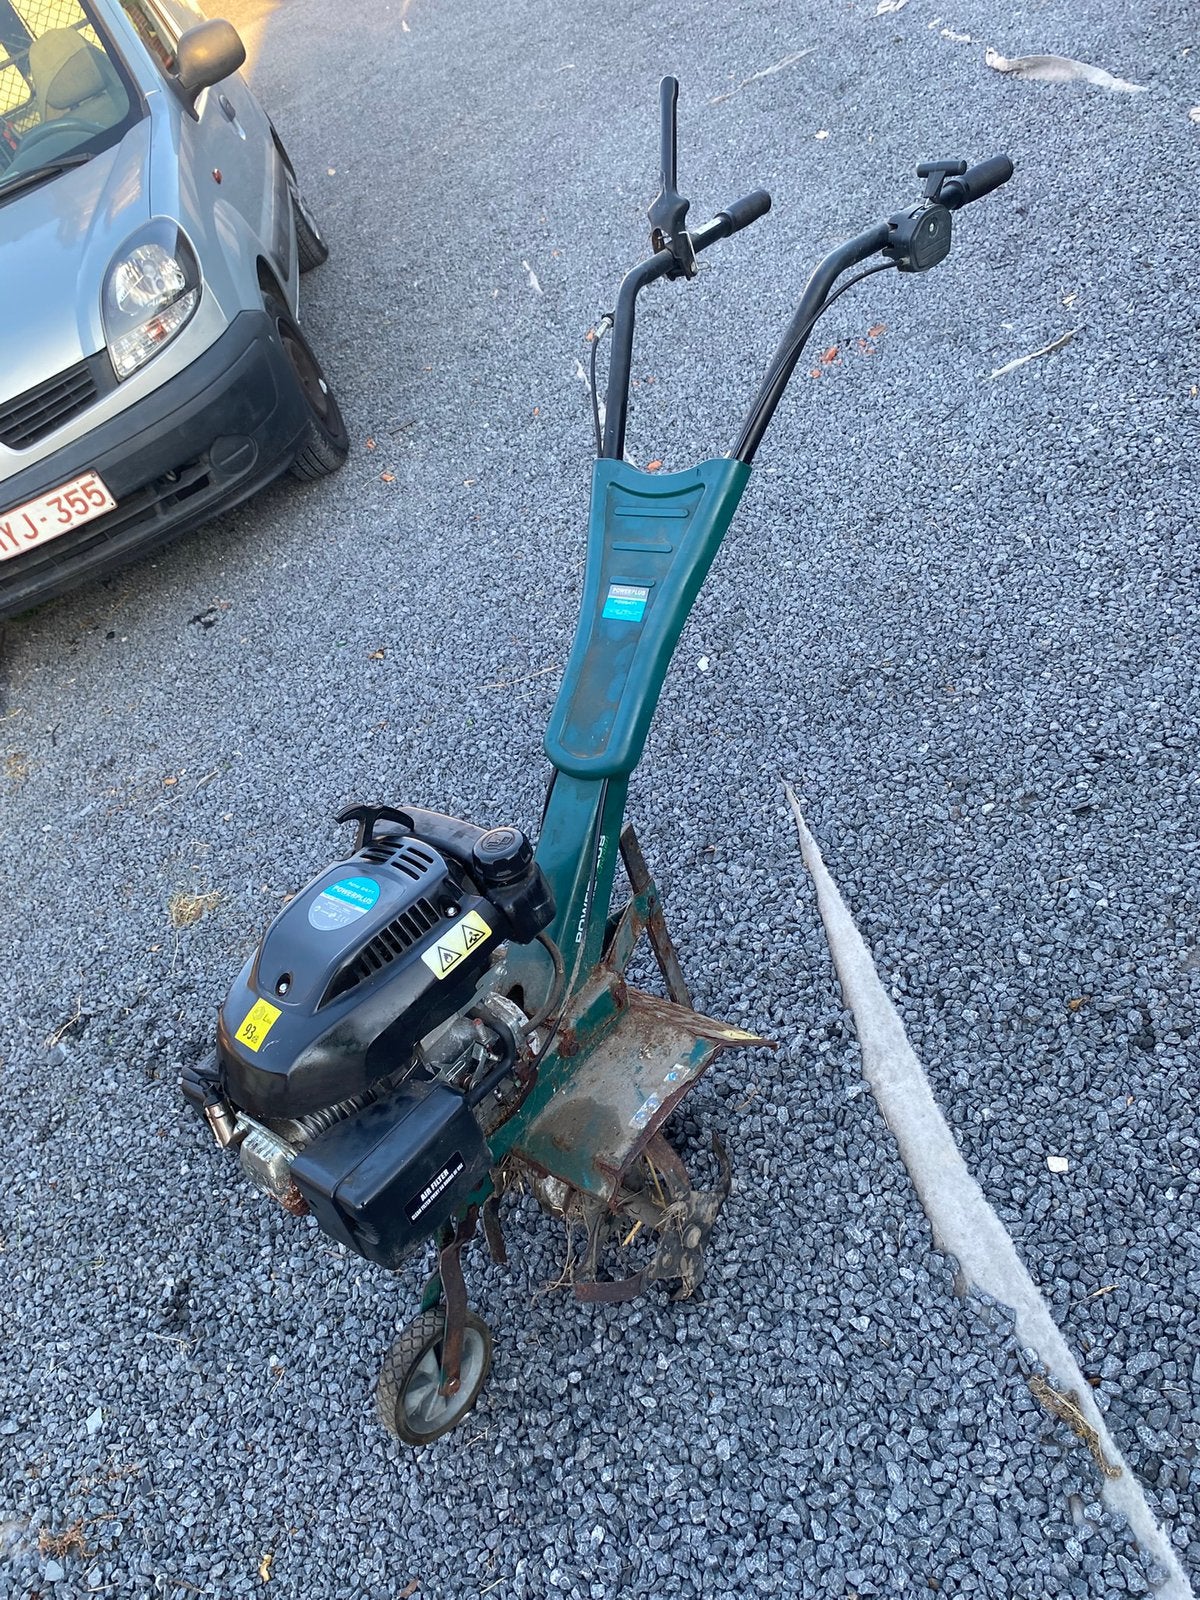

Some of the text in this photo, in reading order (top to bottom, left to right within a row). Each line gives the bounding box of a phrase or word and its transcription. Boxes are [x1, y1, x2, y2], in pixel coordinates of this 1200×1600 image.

[0, 480, 106, 551] YJ-355
[330, 884, 374, 905] POWERPLUS
[420, 1168, 449, 1202] AIR FILTER
